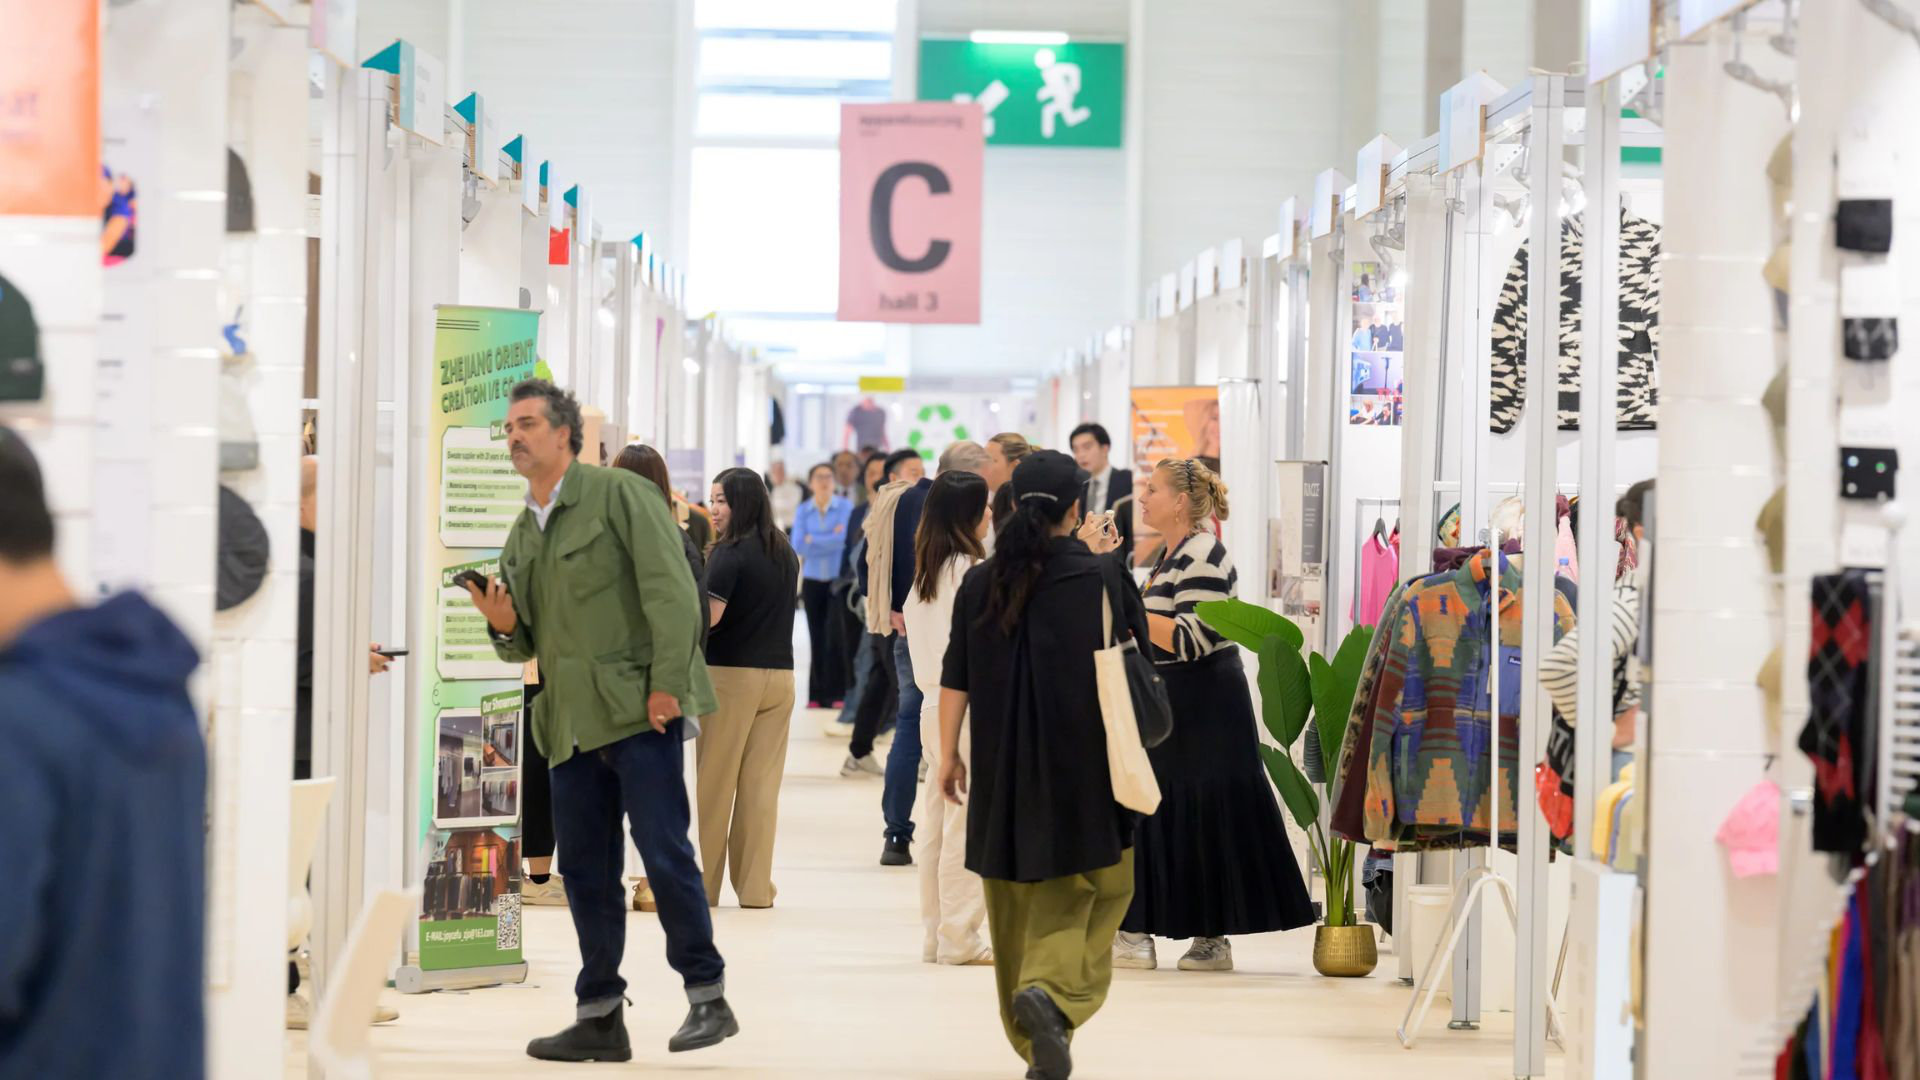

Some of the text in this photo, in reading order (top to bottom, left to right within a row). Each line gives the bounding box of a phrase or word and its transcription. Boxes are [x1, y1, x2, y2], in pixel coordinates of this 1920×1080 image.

[868, 159, 953, 275] C
[879, 291, 940, 312] hall 3
[440, 338, 534, 386] ZHEJIANG ORIENT
[441, 381, 486, 414] CREATION
